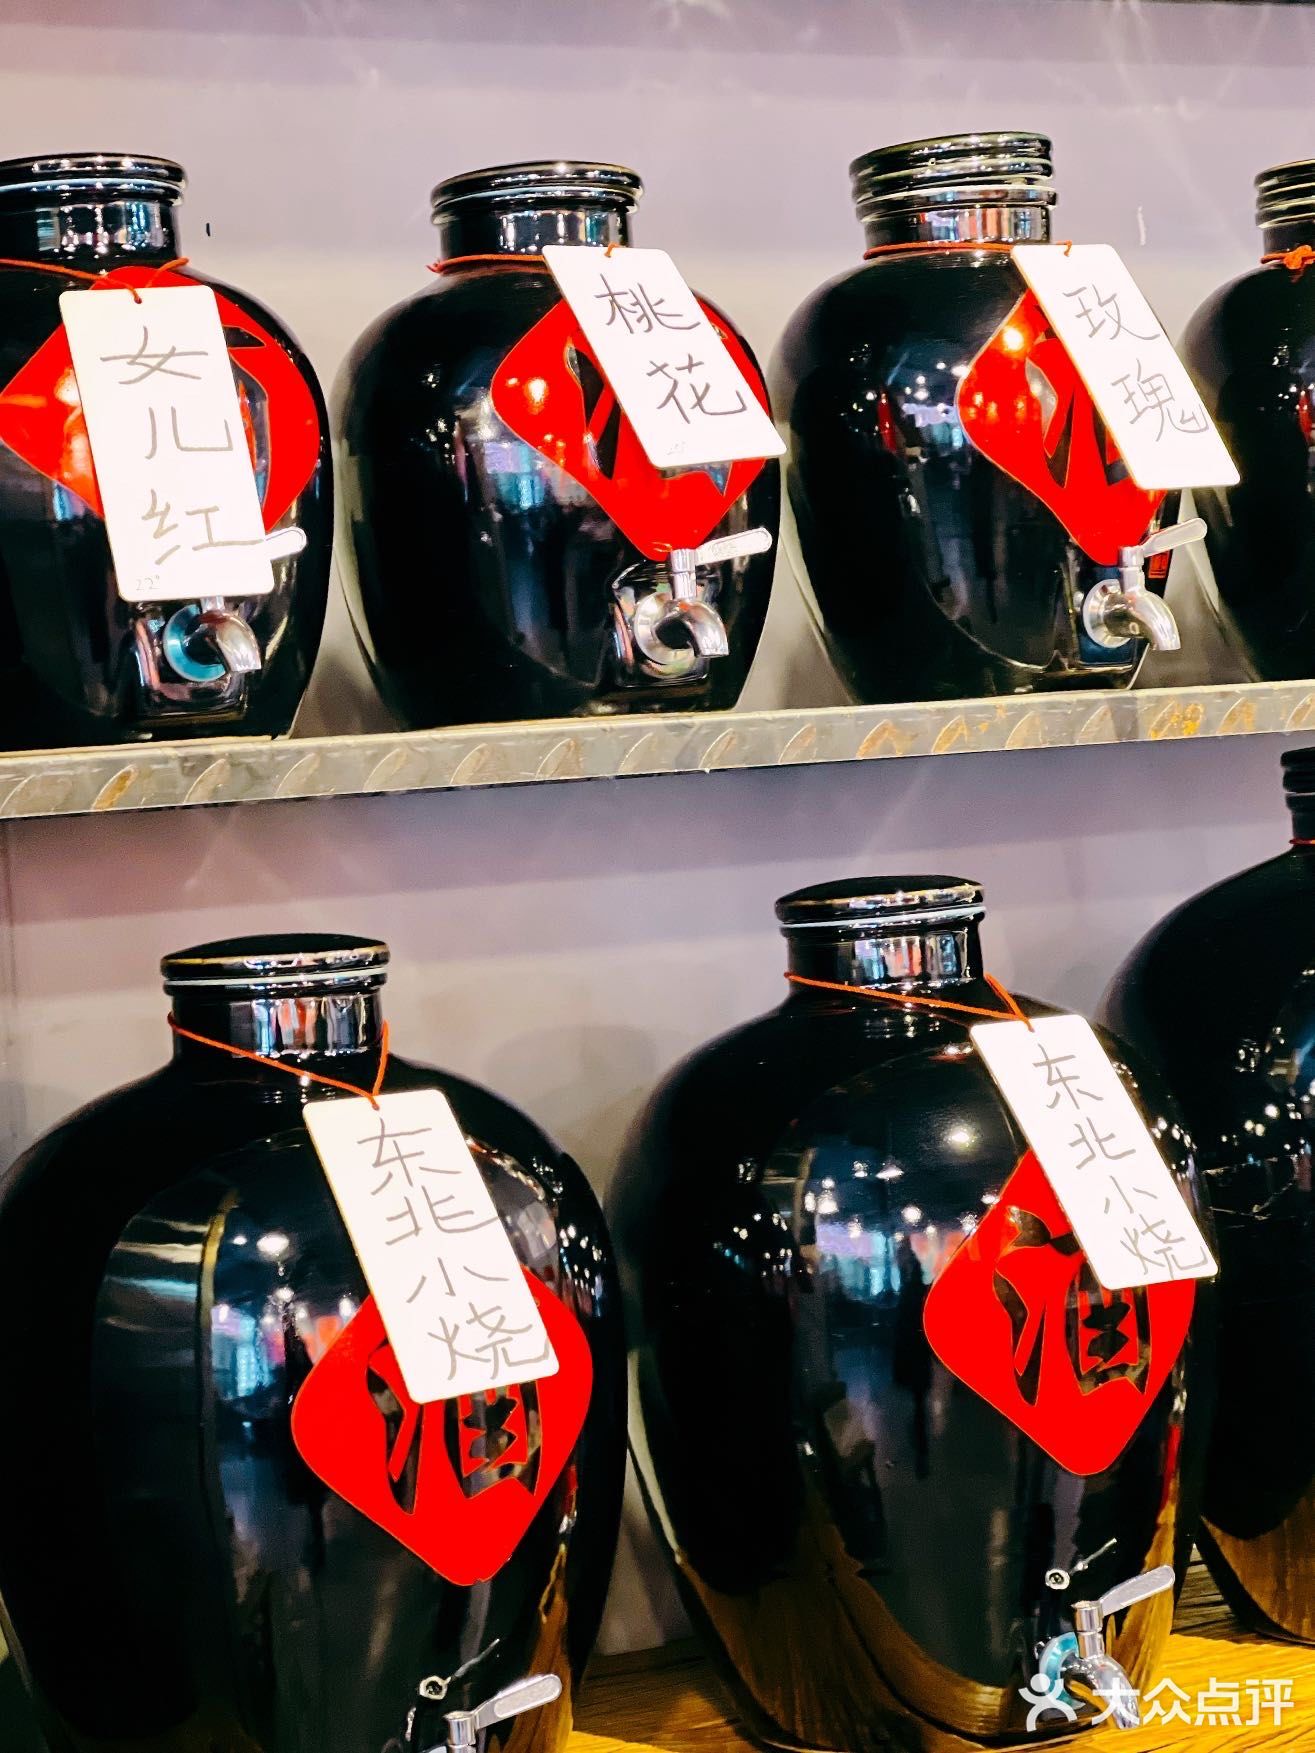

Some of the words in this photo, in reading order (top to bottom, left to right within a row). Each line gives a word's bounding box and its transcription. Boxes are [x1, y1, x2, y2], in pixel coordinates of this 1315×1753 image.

[100, 325, 264, 565] 女儿红
[593, 272, 748, 425] 桃花
[1062, 283, 1210, 443] 玫瑰
[356, 1117, 552, 1380] 东北小烧
[1032, 1042, 1209, 1280] 东北小烧
